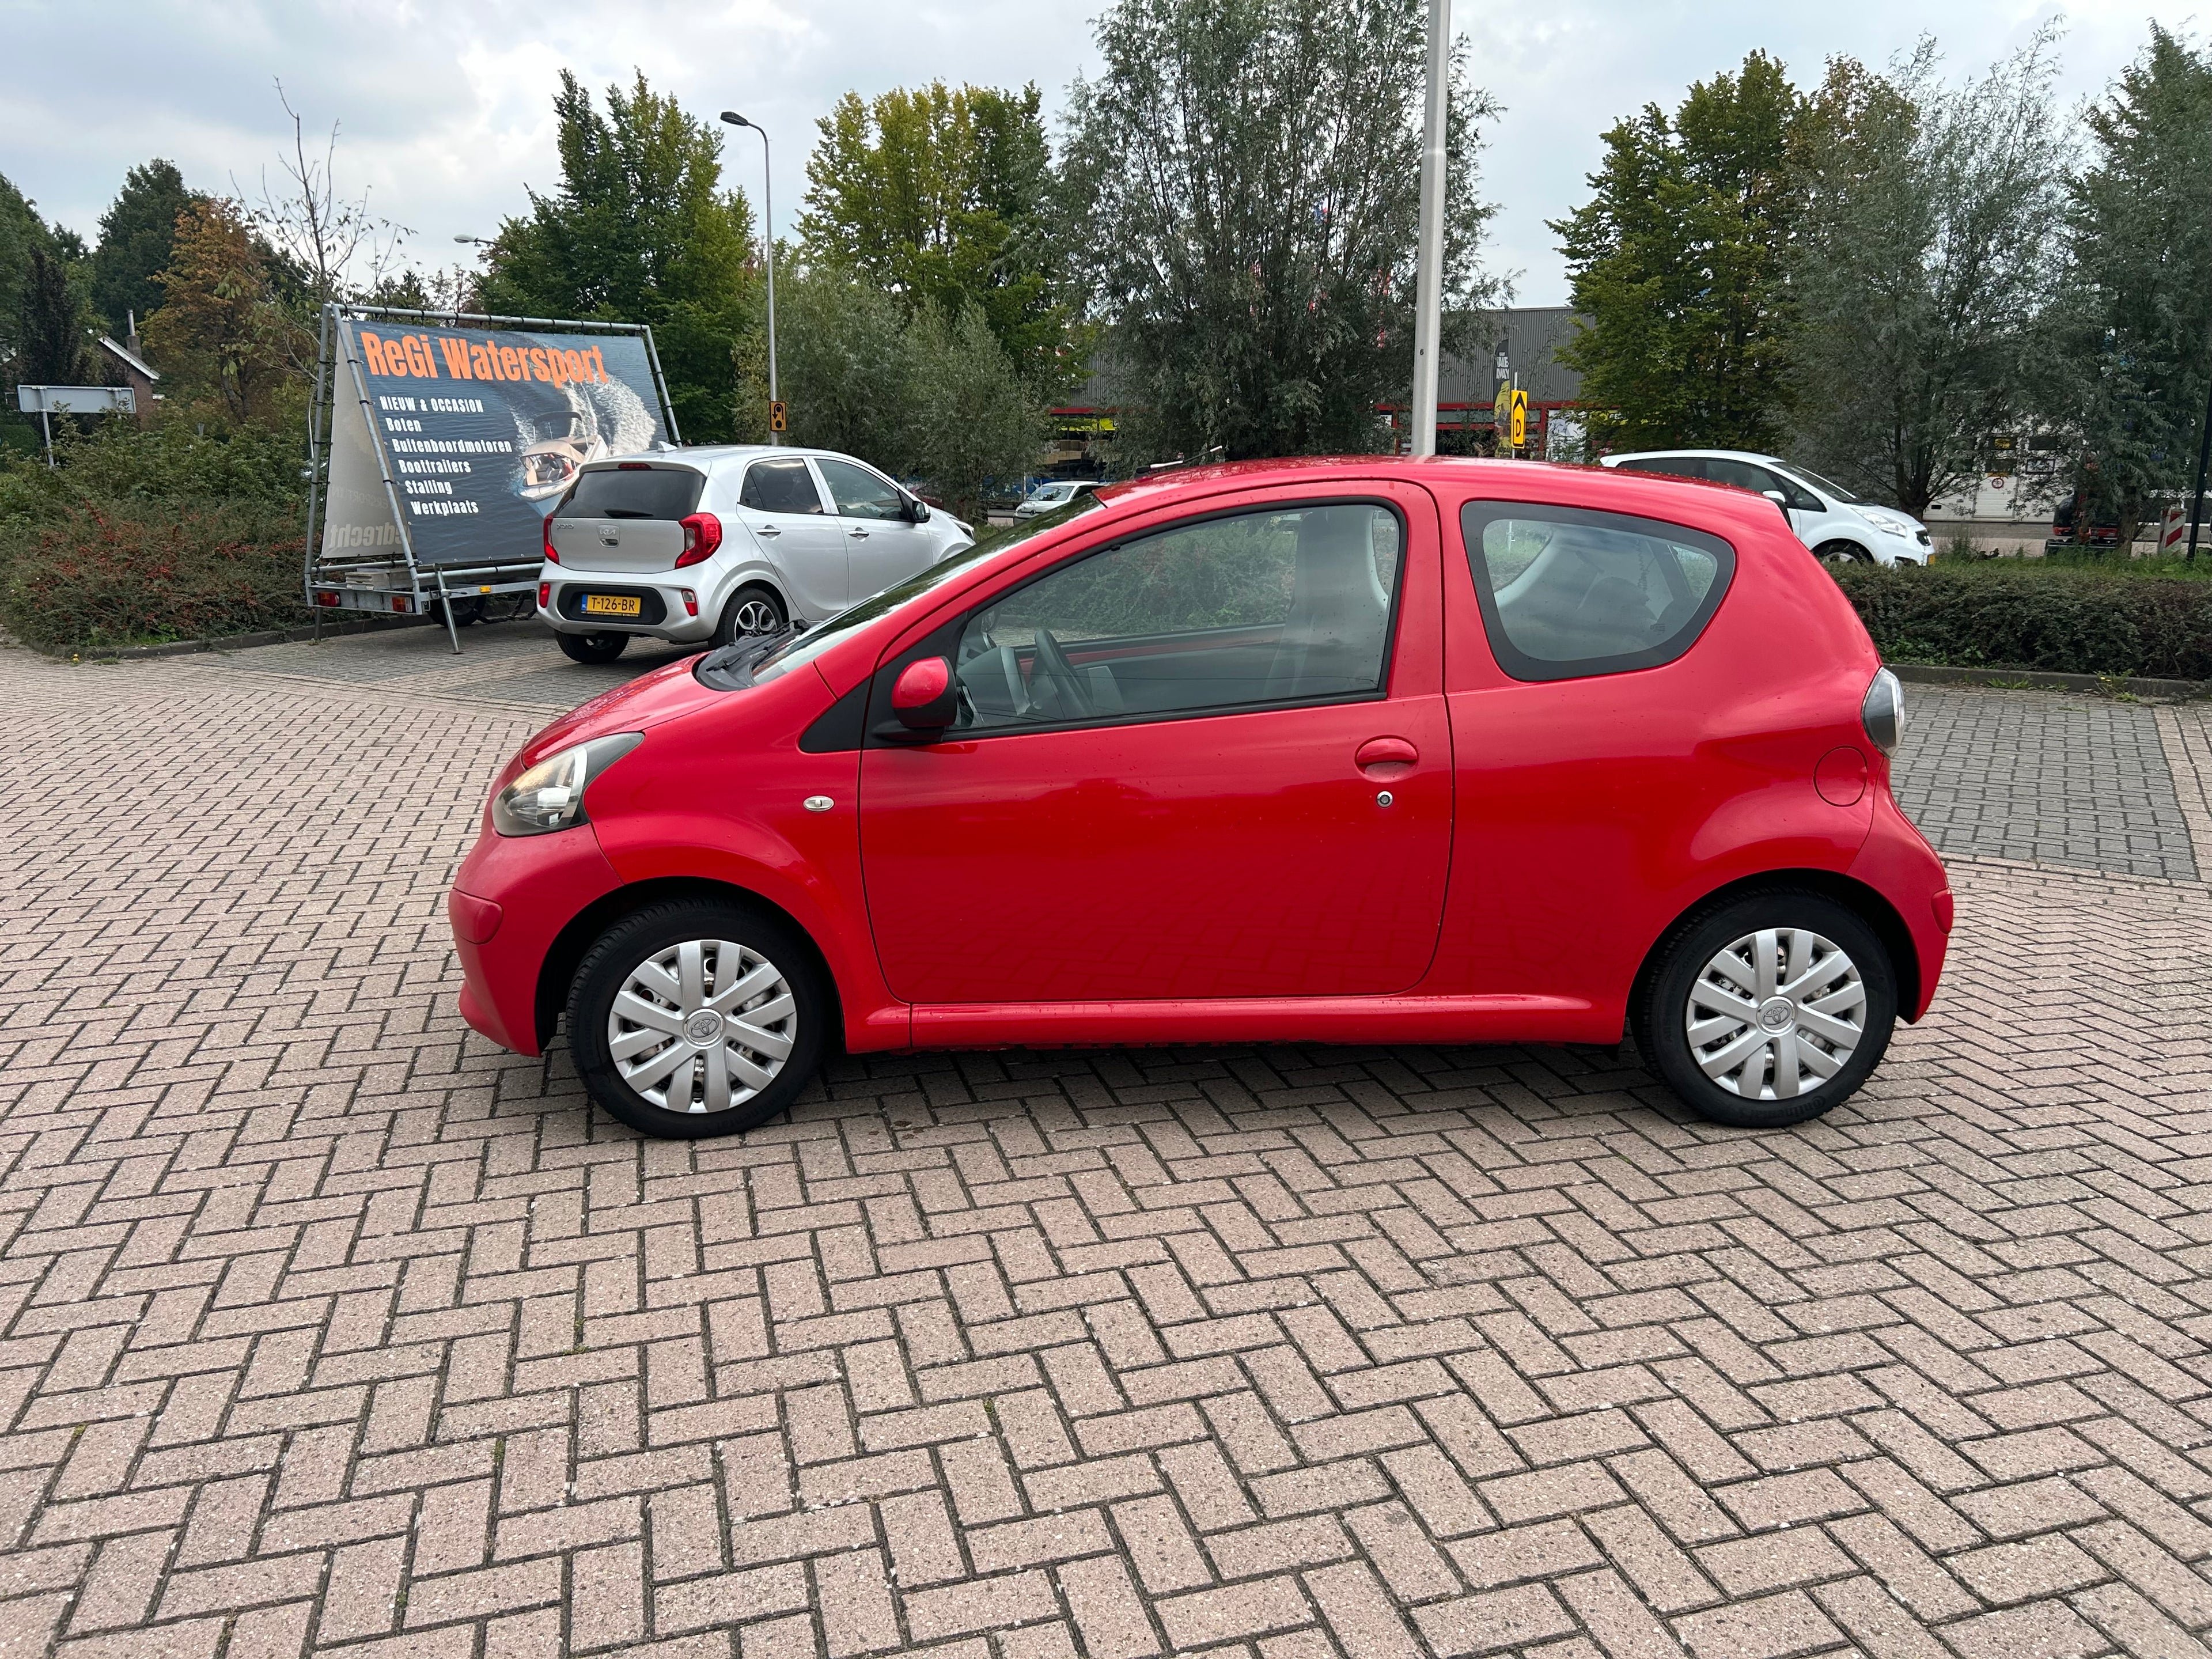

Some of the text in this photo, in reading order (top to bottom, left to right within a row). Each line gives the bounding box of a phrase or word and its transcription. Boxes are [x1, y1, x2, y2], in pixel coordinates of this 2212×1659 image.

[360, 332, 608, 388] ReGi Watersport
[380, 396, 484, 412] NIEUW & OCCASION
[385, 417, 422, 432] Boten
[1516, 419, 1521, 437] D
[392, 438, 513, 453] Buitenboordmotoren
[398, 459, 471, 473] Boottrailers
[404, 479, 453, 495] Stalling
[410, 500, 479, 516] Werkplaats
[592, 597, 635, 612] T-126-BR
